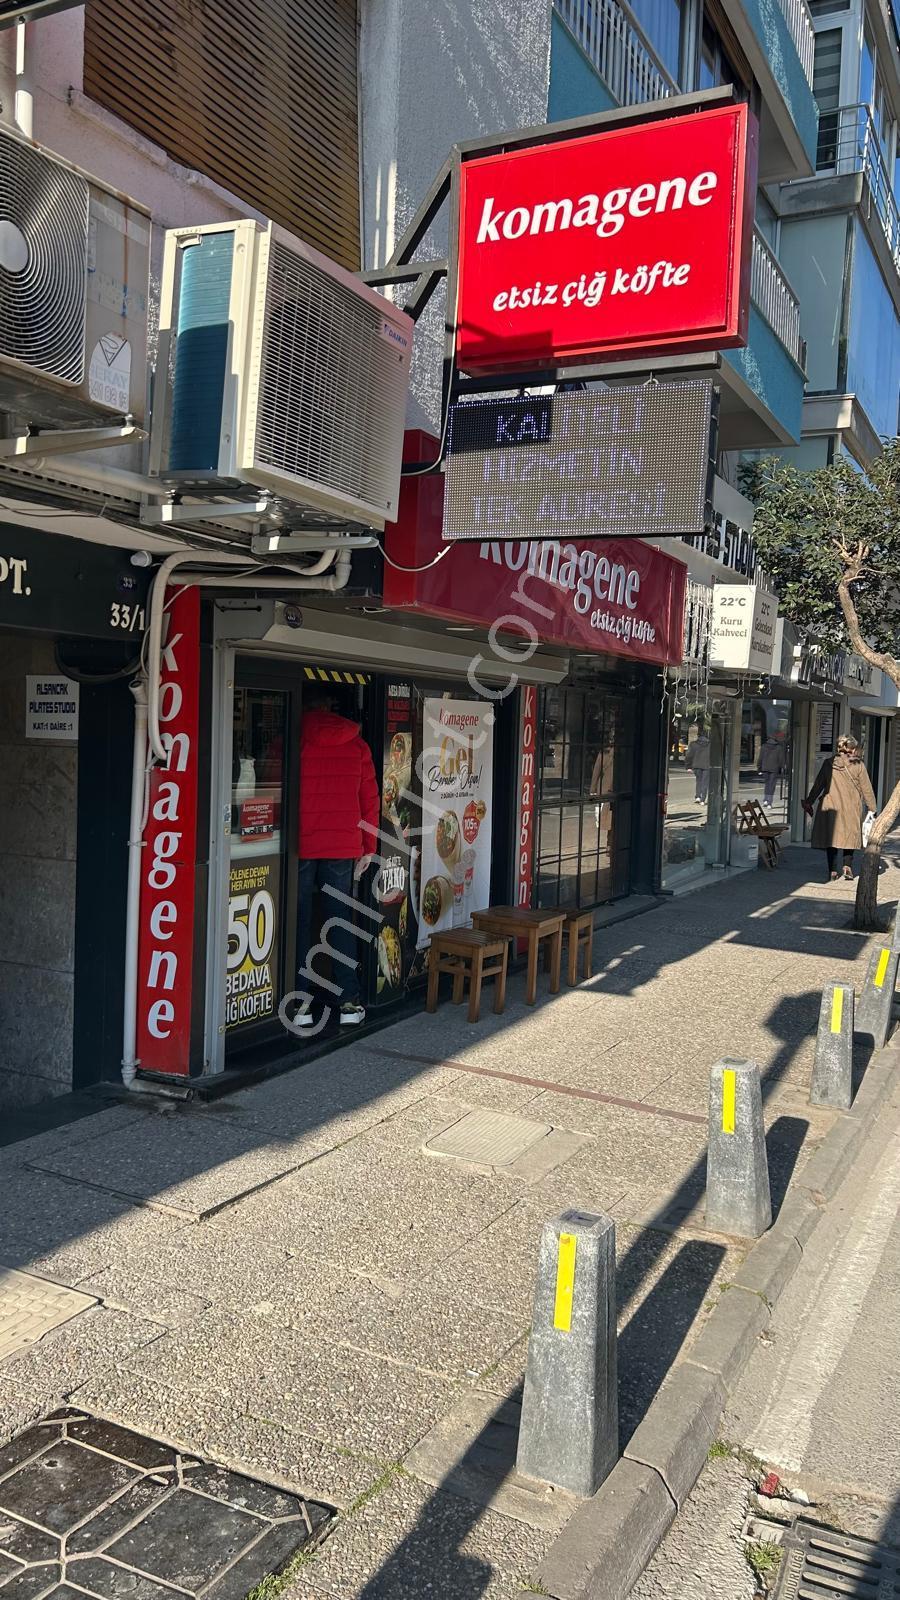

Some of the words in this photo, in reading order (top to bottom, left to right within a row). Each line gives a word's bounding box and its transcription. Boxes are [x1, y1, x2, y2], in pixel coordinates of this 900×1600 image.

[476, 170, 718, 244] komagene
[493, 281, 558, 311] etsiz
[562, 270, 607, 308] çiğ
[611, 260, 691, 296] köfte
[471, 494, 524, 525] TEK
[590, 608, 616, 634] etsiz
[616, 614, 632, 644] çiğ
[632, 617, 656, 645] köfte
[713, 628, 748, 637] Kahveci
[720, 617, 742, 625] Kuru
[37, 684, 68, 695] ALSANCAK
[54, 702, 76, 713] STUDIO
[439, 707, 480, 731] komagene
[440, 733, 474, 776] Gel
[518, 686, 536, 904] komagen
[147, 612, 191, 1039] komagene
[231, 880, 243, 891] HER
[243, 878, 257, 889] AYIN
[249, 865, 270, 878] DEVAM
[382, 866, 405, 895] TAKO
[228, 889, 275, 970] 50
[226, 996, 238, 1023] İĞ
[239, 990, 272, 1018] KÖFTE
